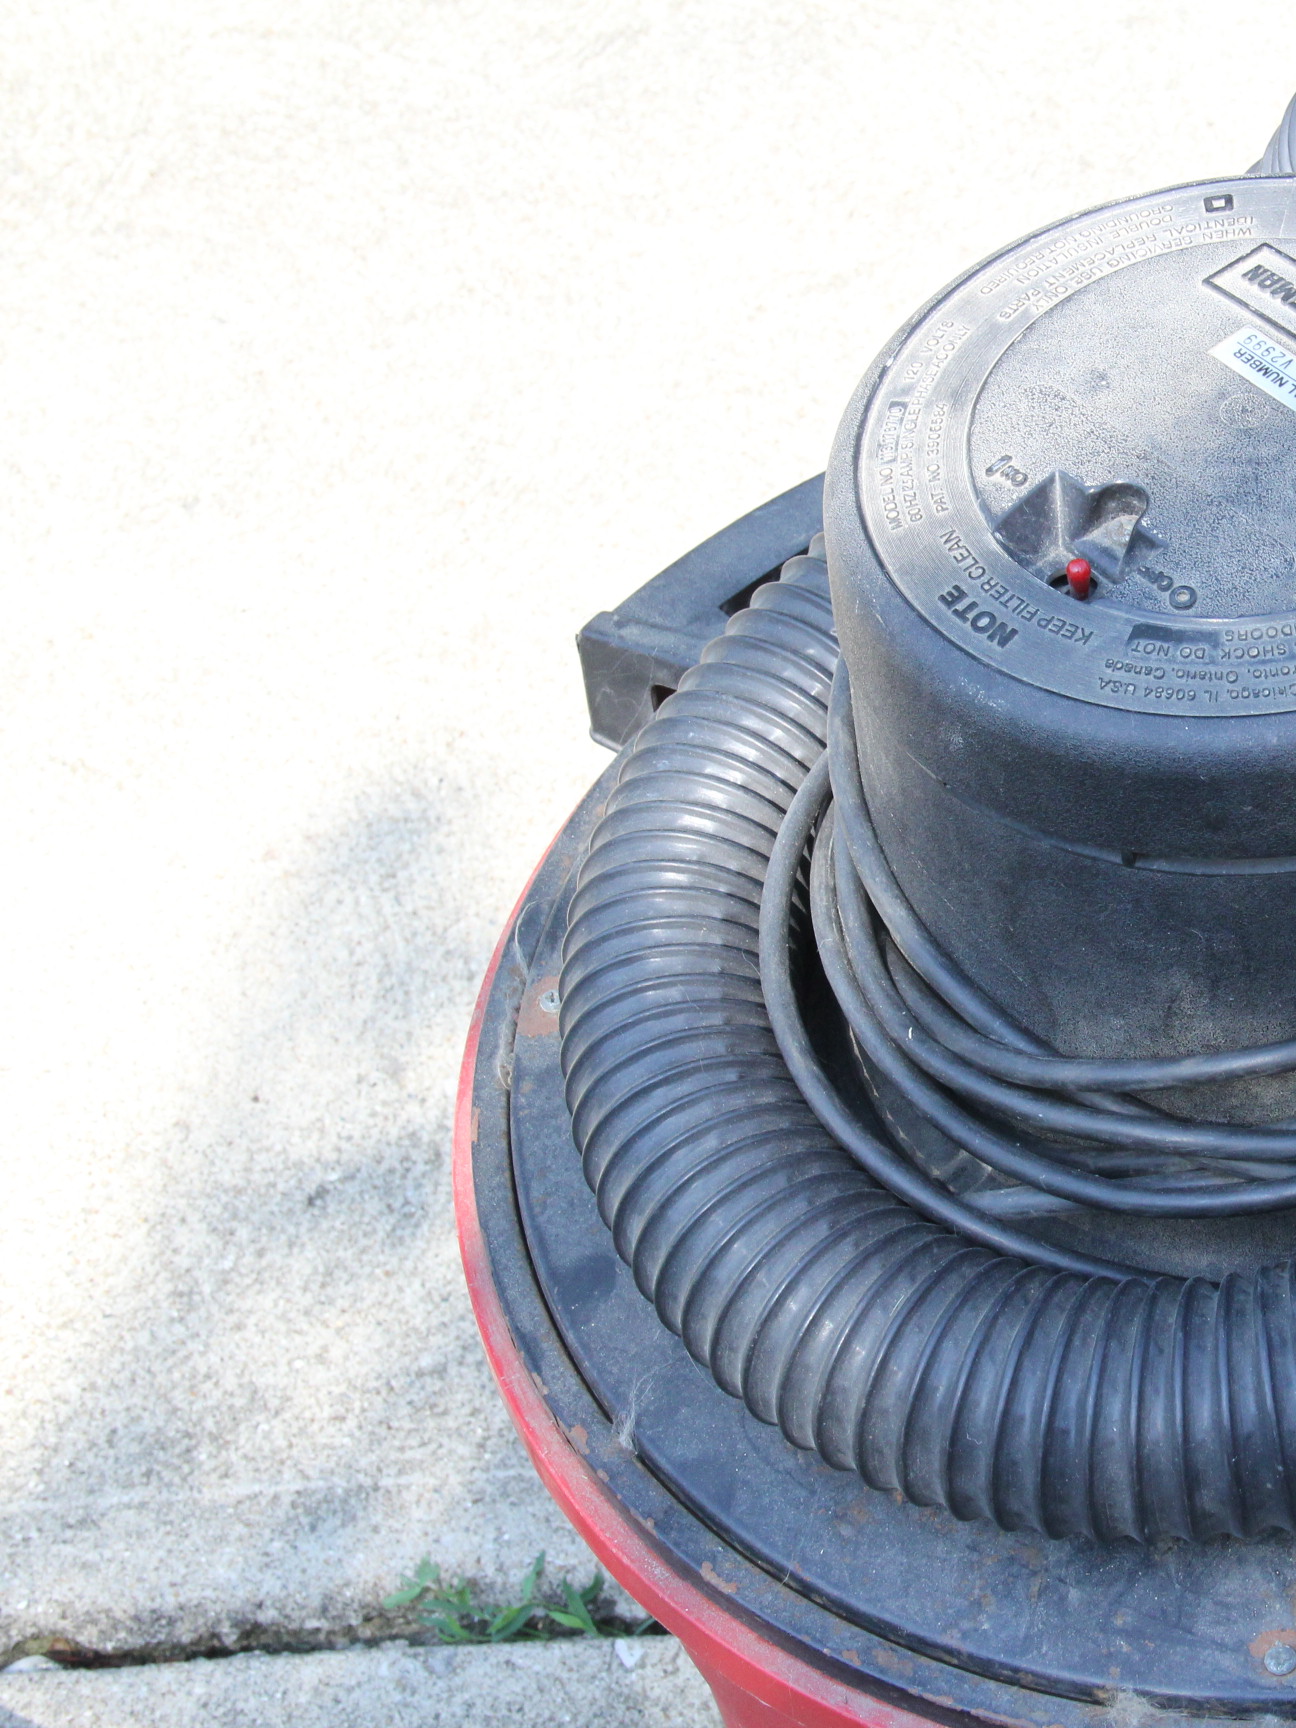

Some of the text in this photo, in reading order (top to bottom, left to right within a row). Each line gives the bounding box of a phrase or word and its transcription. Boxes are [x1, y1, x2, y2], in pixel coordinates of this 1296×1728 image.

[980, 205, 1173, 294] GROUNDING NOT REQUIRED
[1016, 215, 1172, 284] DOUBLE INSULATION
[999, 216, 1253, 320] IDENTICAL REPLACEMENT PARTS
[1033, 228, 1251, 311] WHEN SERVICING USE ONLY
[943, 326, 970, 352] ONLY
[931, 352, 948, 368] AC
[1234, 348, 1288, 388] NUMBER
[911, 370, 938, 406] PHASE
[882, 488, 902, 530] MODEL
[904, 362, 923, 382] 120
[901, 408, 921, 449] SINGLE
[907, 508, 923, 522] 60
[940, 529, 1094, 646] KEEP FILTER CLEAN
[938, 584, 1018, 648] NOTE
[1131, 642, 1170, 657] NOT
[1180, 647, 1205, 660] DO
[1220, 644, 1286, 660] SHOCK
[1105, 659, 1165, 680] Canada
[1144, 686, 1196, 701] 60684
[1204, 690, 1218, 702] IL
